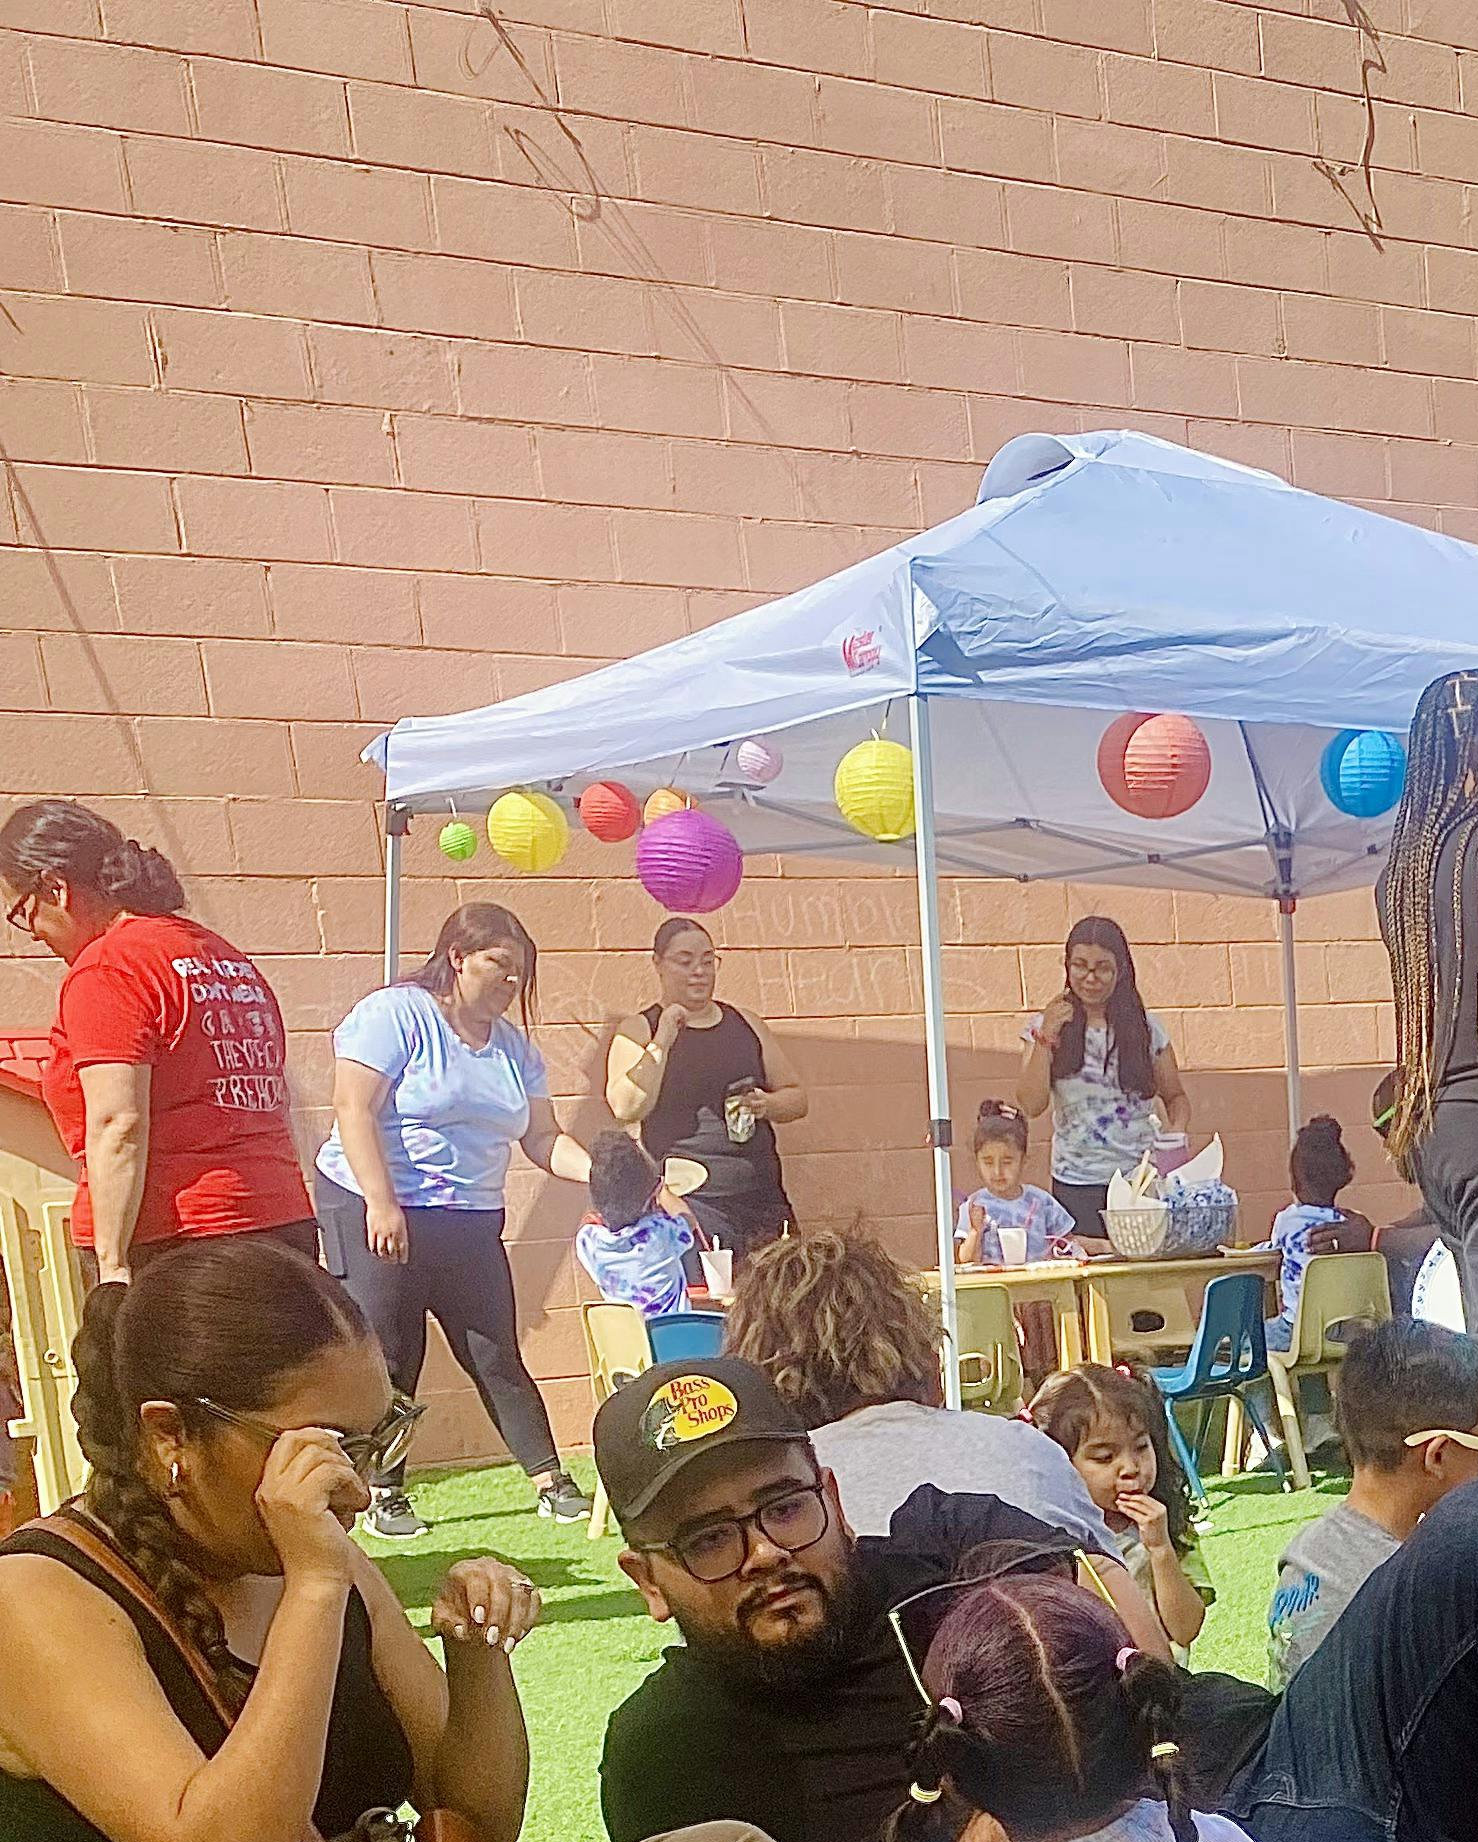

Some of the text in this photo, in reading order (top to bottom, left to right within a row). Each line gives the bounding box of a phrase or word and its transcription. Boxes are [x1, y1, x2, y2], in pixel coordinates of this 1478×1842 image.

[670, 1378, 710, 1400] Bass
[679, 1393, 708, 1414] Pro
[688, 1403, 734, 1428] Shops
